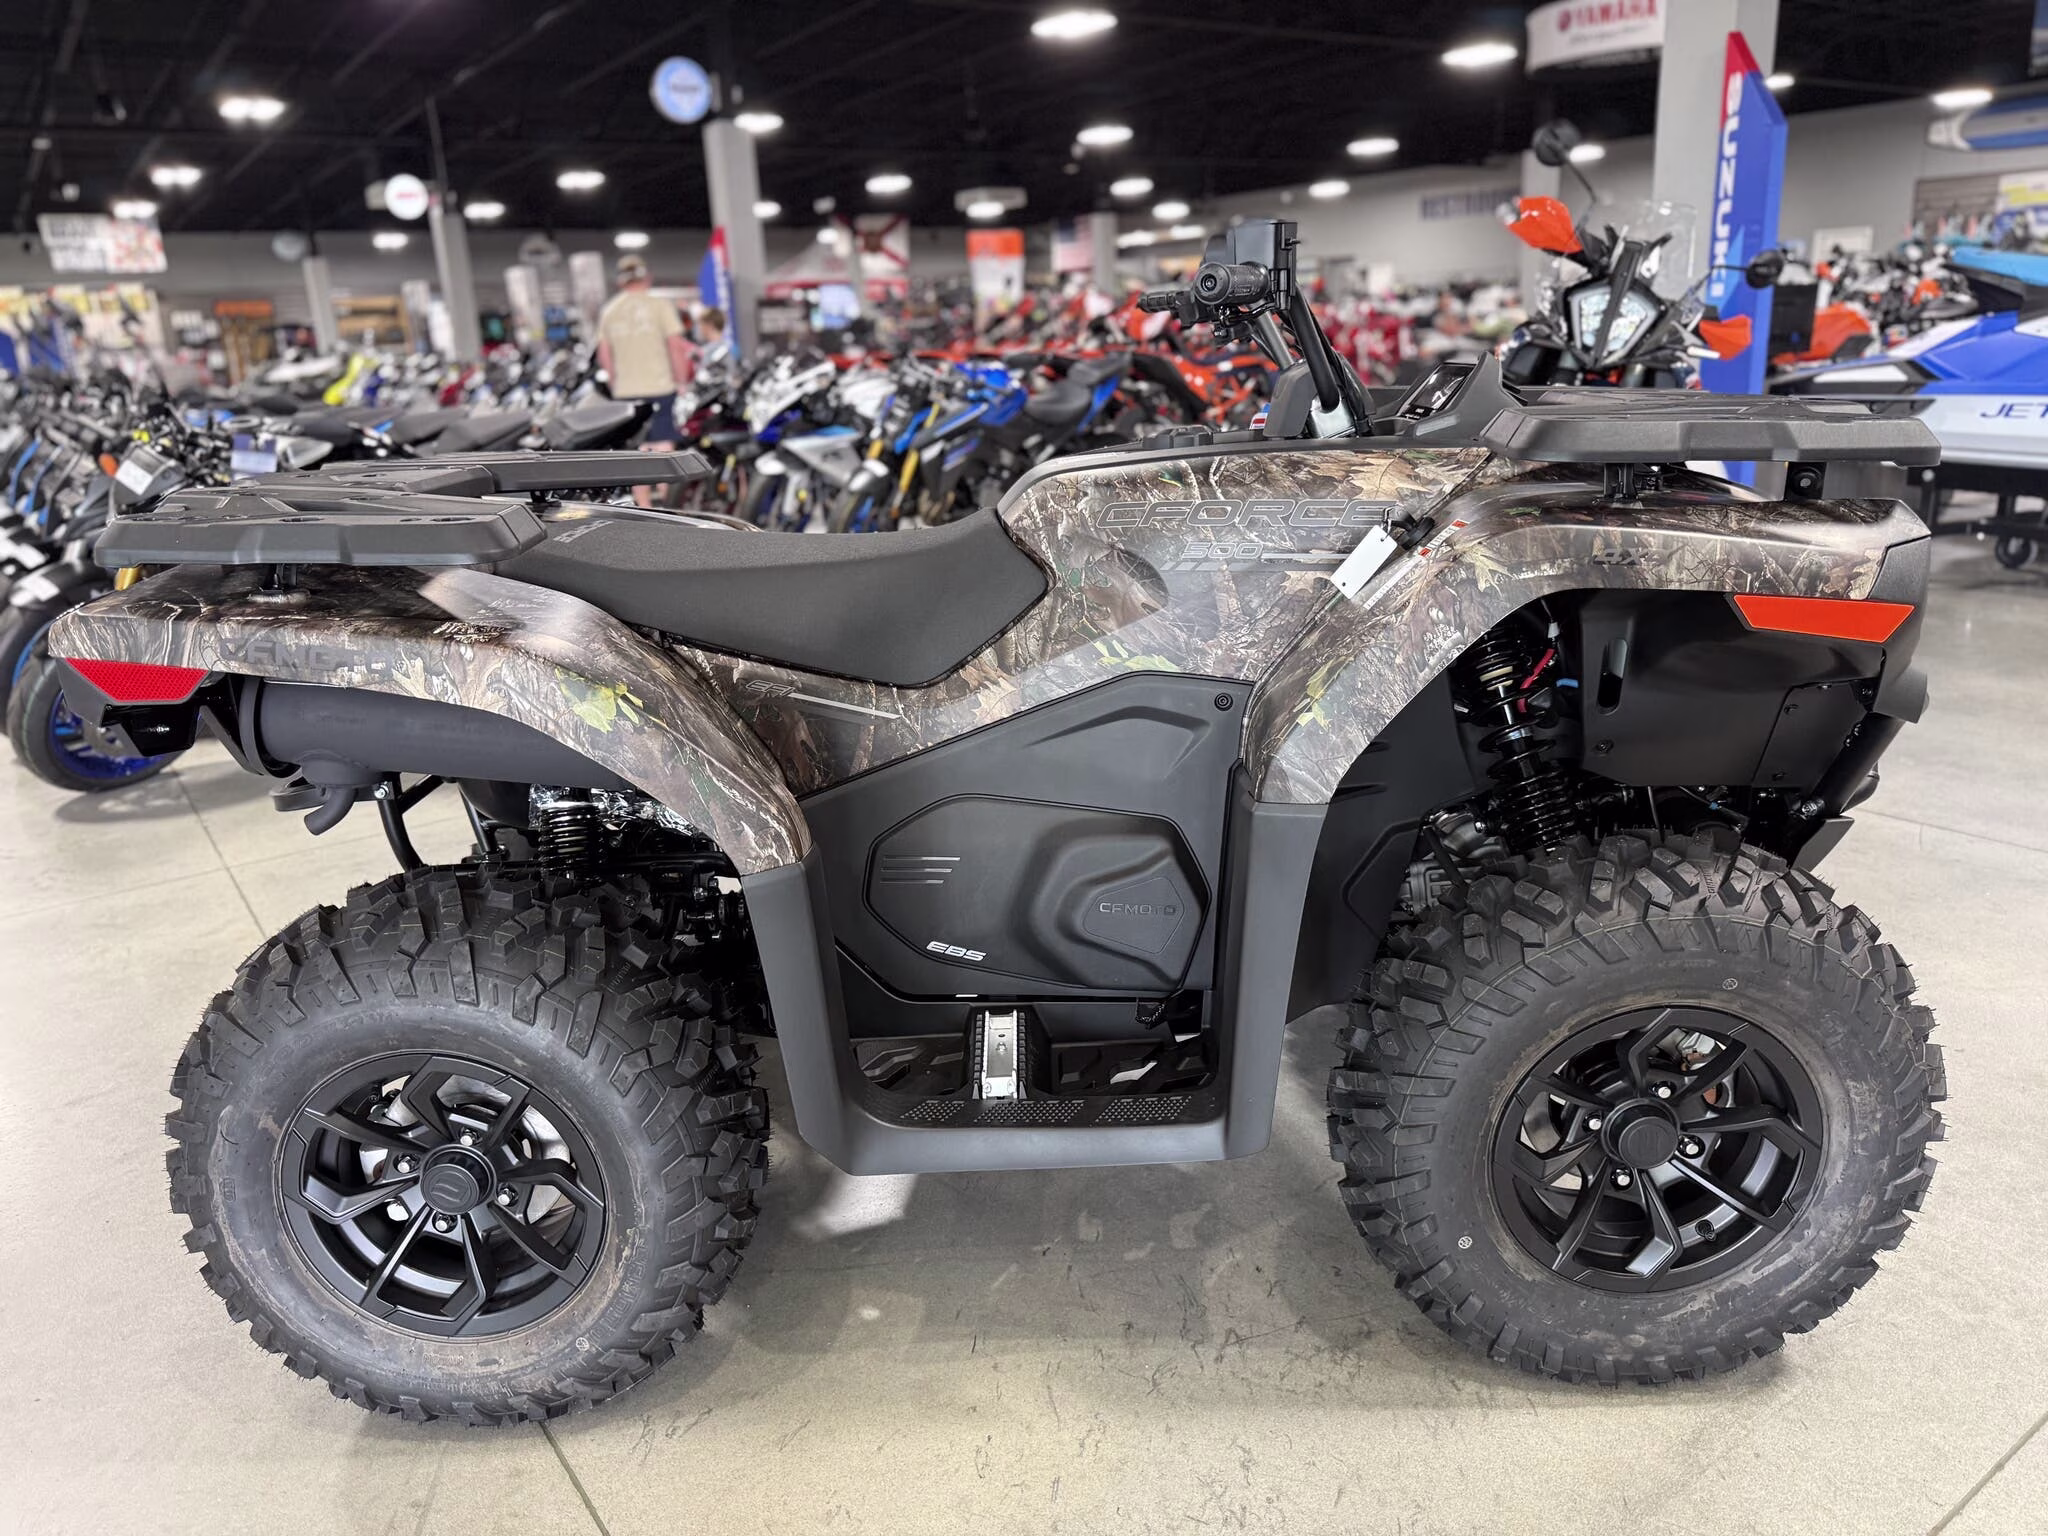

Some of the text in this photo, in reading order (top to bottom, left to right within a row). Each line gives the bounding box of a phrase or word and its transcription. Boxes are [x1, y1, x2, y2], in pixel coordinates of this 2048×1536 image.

[1576, 0, 1656, 26] YAMAHA
[1710, 71, 1743, 297] SUZUKI
[1096, 499, 1398, 529] CFORCE
[1182, 542, 1264, 560] 500
[746, 679, 797, 697] EFI
[1099, 902, 1177, 917] CFMOTO
[926, 940, 988, 962] EBS
